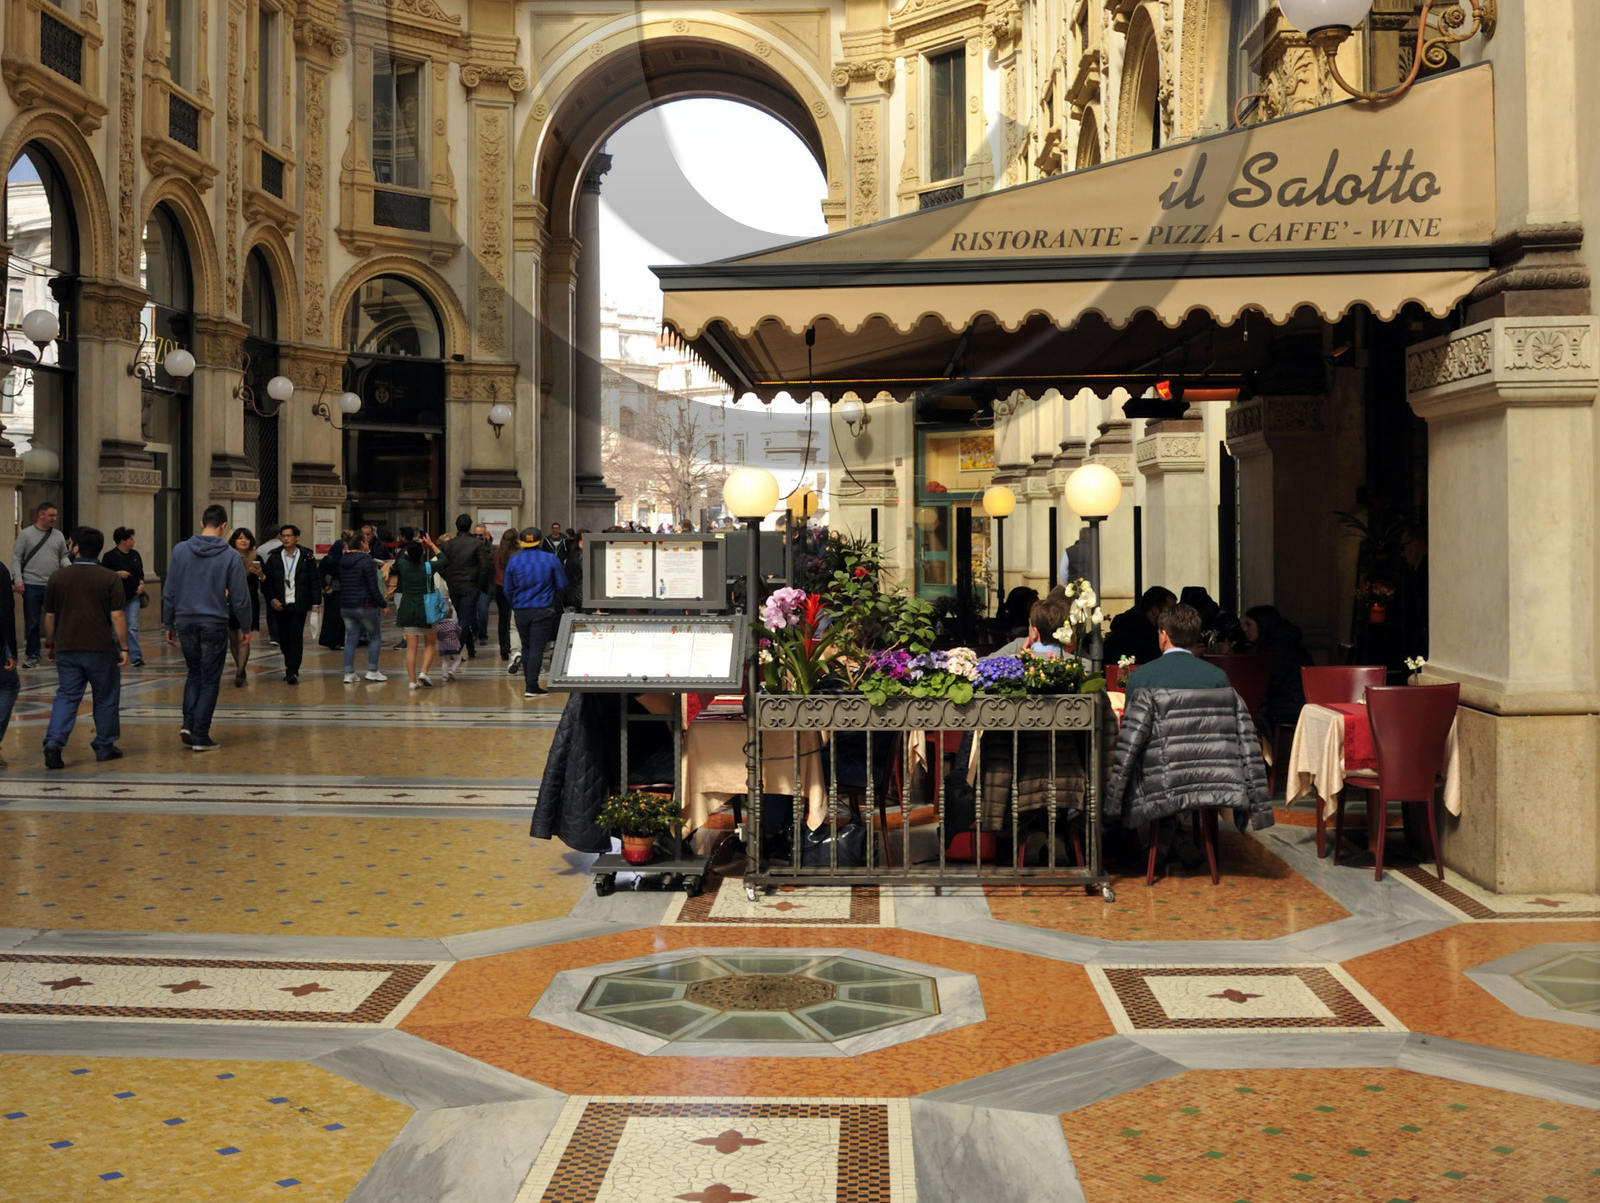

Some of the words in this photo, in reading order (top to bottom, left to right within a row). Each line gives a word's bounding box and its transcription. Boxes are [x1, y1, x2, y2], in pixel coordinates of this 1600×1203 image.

[1159, 152, 1208, 210] il
[1228, 148, 1441, 208] Salotto
[950, 226, 1123, 252] RISTORANTE
[1146, 224, 1225, 245] PIZZA
[1371, 218, 1442, 239] WINE
